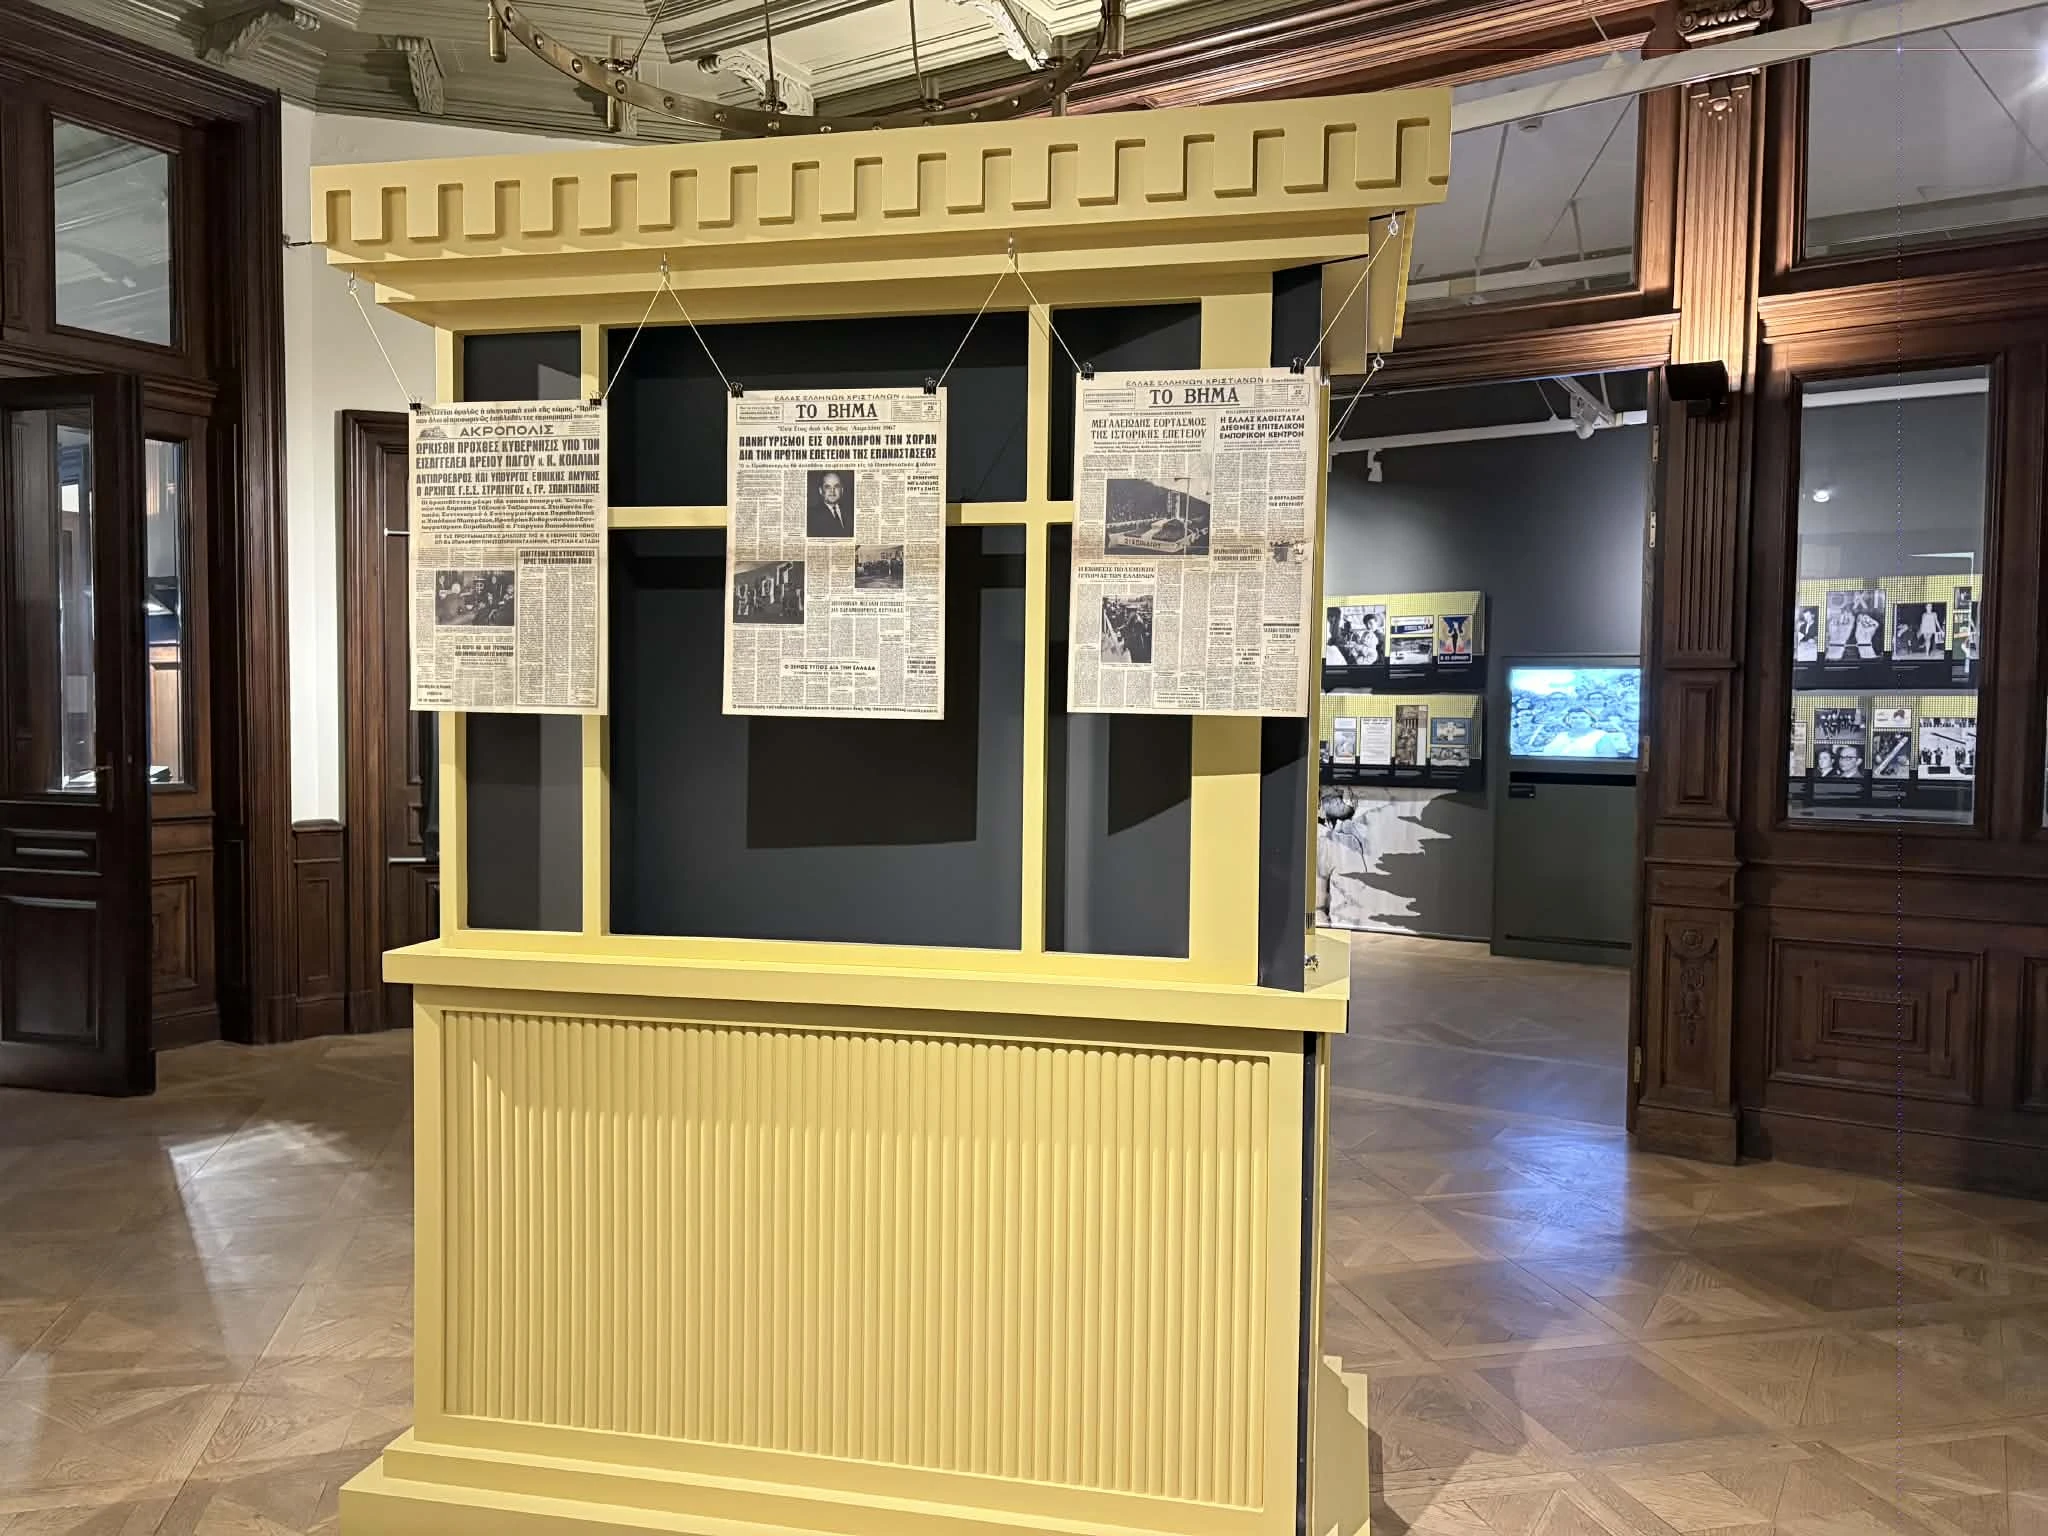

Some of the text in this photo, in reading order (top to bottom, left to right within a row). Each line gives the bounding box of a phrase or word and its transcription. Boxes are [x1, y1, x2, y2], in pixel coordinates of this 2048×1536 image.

[1205, 377, 1264, 385] ΧΡΙΣΤΙΑΝΩΝ
[847, 393, 900, 401] ΧΡΙΣΤΙΑΝΩΝ
[1149, 389, 1173, 404] ΤΟ
[1184, 388, 1240, 403] ΒΗΜΑ
[796, 404, 817, 418] ΤΟ
[827, 403, 878, 418] ΒΗΜΑ
[1091, 417, 1207, 429] ΜΕΓΑΛΕΙΩΔΗΣ ΕΟΡΤΑΣΜΟΣ
[1228, 415, 1255, 423] ΕΛΛΑΣ
[1256, 414, 1305, 422] ΚΑΘΙΣΤΑΤΑΙ
[459, 424, 554, 437] ΑΚΡΟΠΟΛΙΣ
[1090, 428, 1207, 440] ΤΗΣ ΙΣΤΟΡΙΚΗΣ ΕΠΕΤΕΙΟΥ
[1219, 430, 1305, 439] ΕΜΠΟΡΙΚΟΝ ΚΕΝΤΡΟΝ
[416, 438, 600, 455] ΩΡΚΙΣΘΗ ΠΡΟΧΘΕΣ ΚΥΒΕΡΝΗΣΙΣ ΥΠΟ ΤΟΝ
[739, 434, 937, 448] ΠΑΝΗΓΥΡΙΣΜΟΙ ΕΙΣ ΟΛΟΚΛΗΡΟΝ ΤΗΝ ΧΩΡΑΝ
[739, 447, 937, 460] ΔΙΑ ΤΗΝ ΠΡΩΤΗΝ ΕΠΕΤΕΙΟΝ ΤΗΣ ΕΠΑΝΑΣΤΑΣΕΩΣ
[416, 456, 467, 469] ΕΙΣΑΓΓΕΛΕΑ
[469, 456, 503, 468] ΑΡΕΙΟΥ
[505, 455, 536, 467] ΠΑΓΟΥ
[416, 470, 600, 484] ΑΝΤΙΠΡΟΕΔΡΟΣ ΚΑΙ ΥΠΟΥΡΓΟΣ ΕΘΝΙΚΗΣ ΑΜΥΝΗΣ
[424, 486, 456, 496] ΑΡΧΗΓΟΣ
[458, 485, 480, 496] Γ.Ε.Σ.
[481, 484, 524, 496] ΣΤΡΑΤΗΓΟΣ
[534, 484, 546, 494] ΓΡ.
